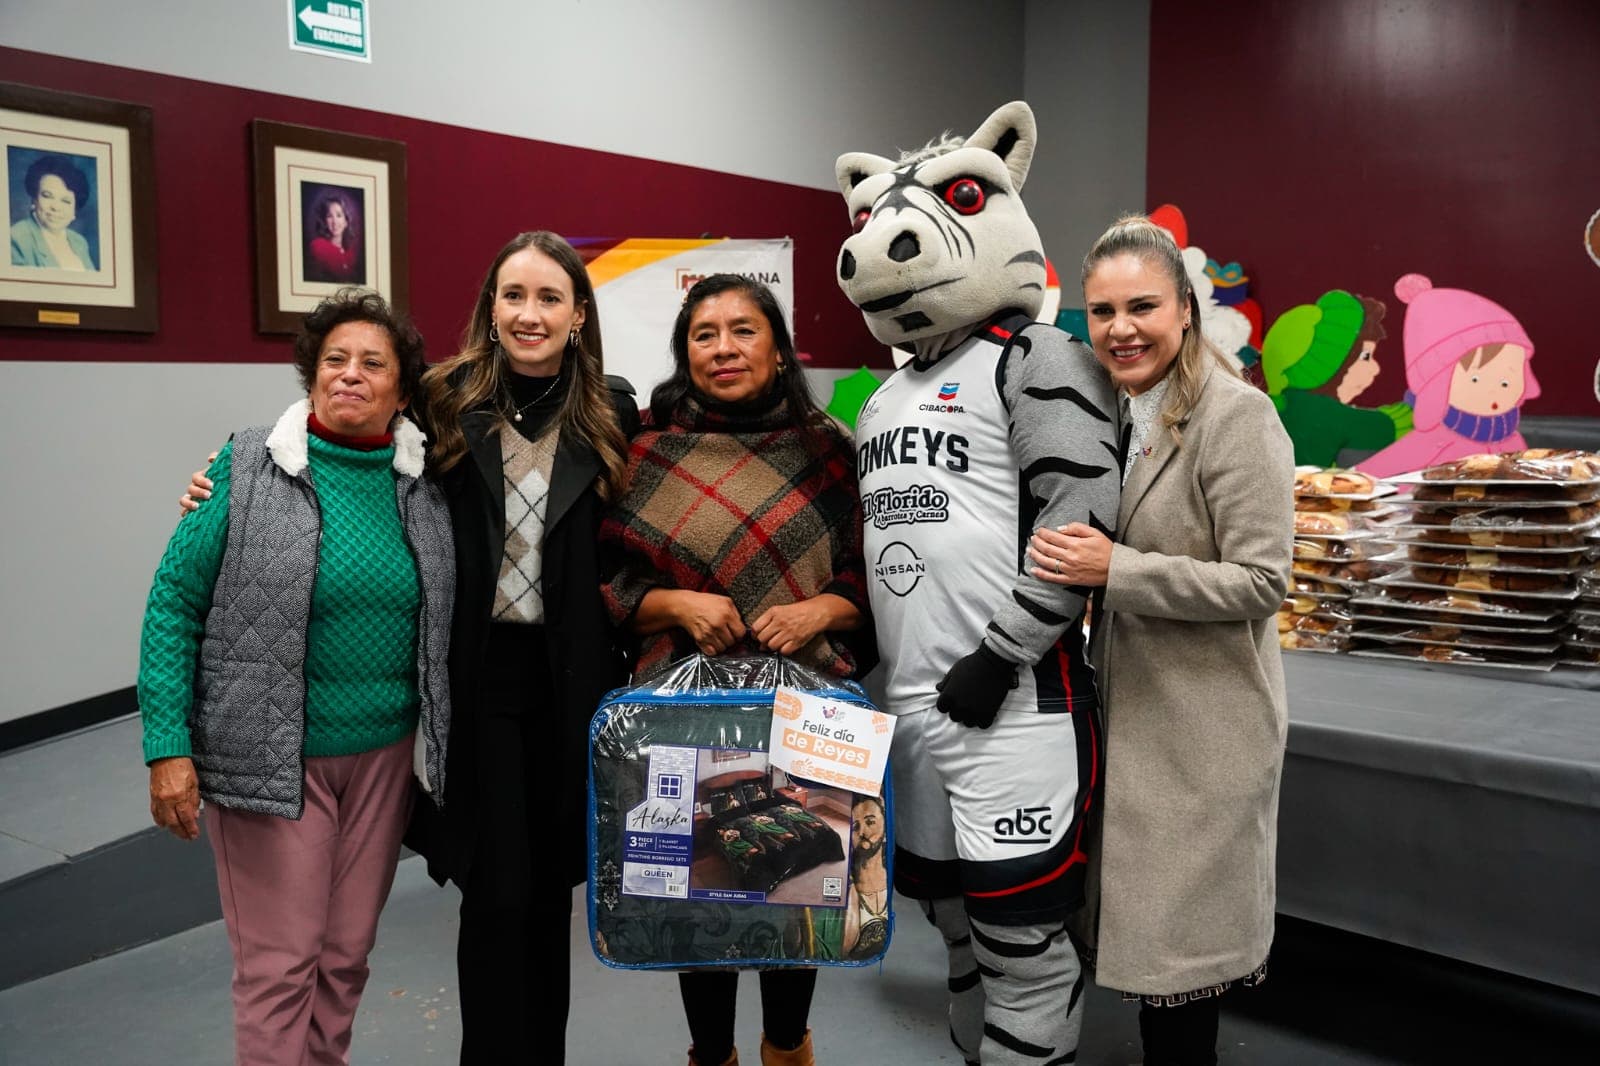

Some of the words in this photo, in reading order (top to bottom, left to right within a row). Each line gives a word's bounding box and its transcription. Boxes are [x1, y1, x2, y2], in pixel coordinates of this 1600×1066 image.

[860, 426, 969, 480] ONKEYS
[875, 489, 945, 513] Florido
[875, 563, 925, 577] NISSAN
[802, 720, 831, 737] Feliz
[834, 728, 855, 743] día
[786, 732, 808, 748] de
[813, 739, 865, 764] Reyes
[632, 808, 688, 829] Alaska
[994, 808, 1052, 836] abc
[629, 836, 638, 847] 3
[644, 870, 673, 878] QUEEN
